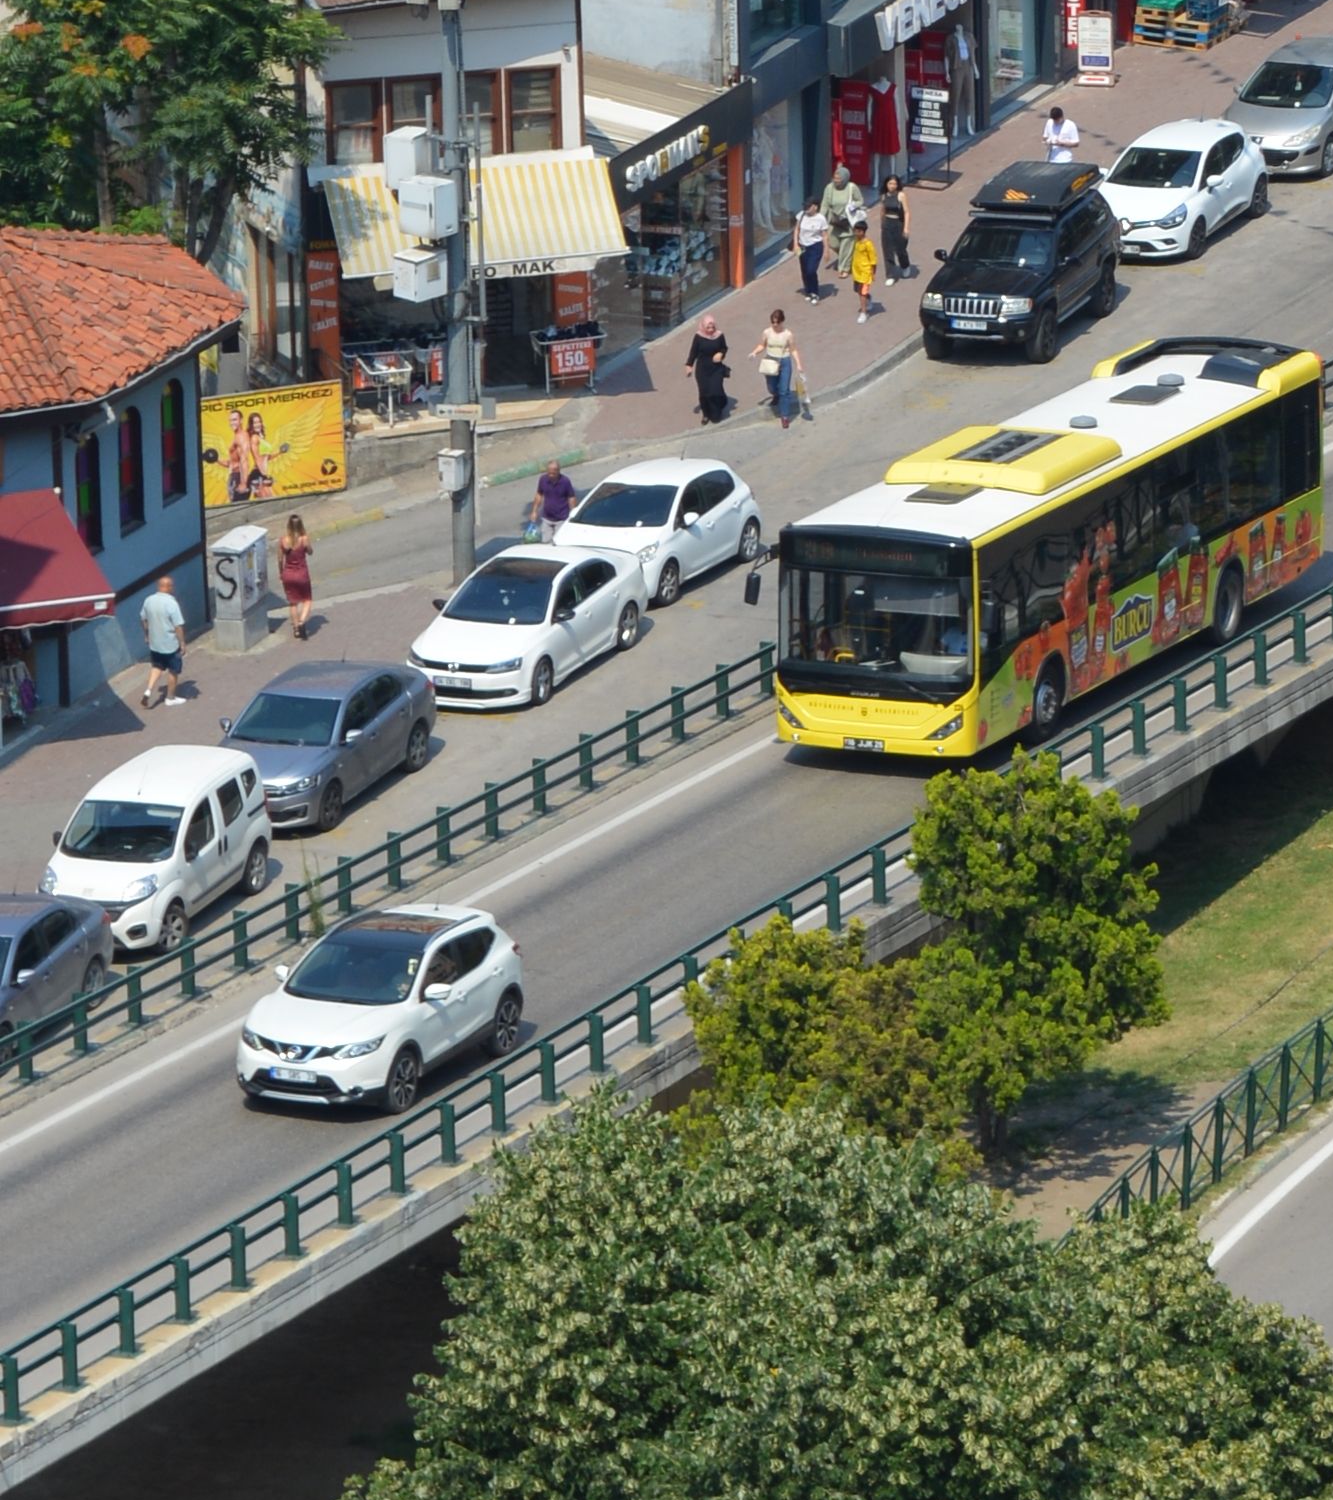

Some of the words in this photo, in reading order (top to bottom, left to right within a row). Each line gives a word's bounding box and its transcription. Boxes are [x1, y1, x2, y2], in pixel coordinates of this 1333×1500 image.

[225, 397, 266, 412] SPOR
[267, 388, 333, 405] MERKEZİ
[1115, 608, 1151, 642] BURCU
